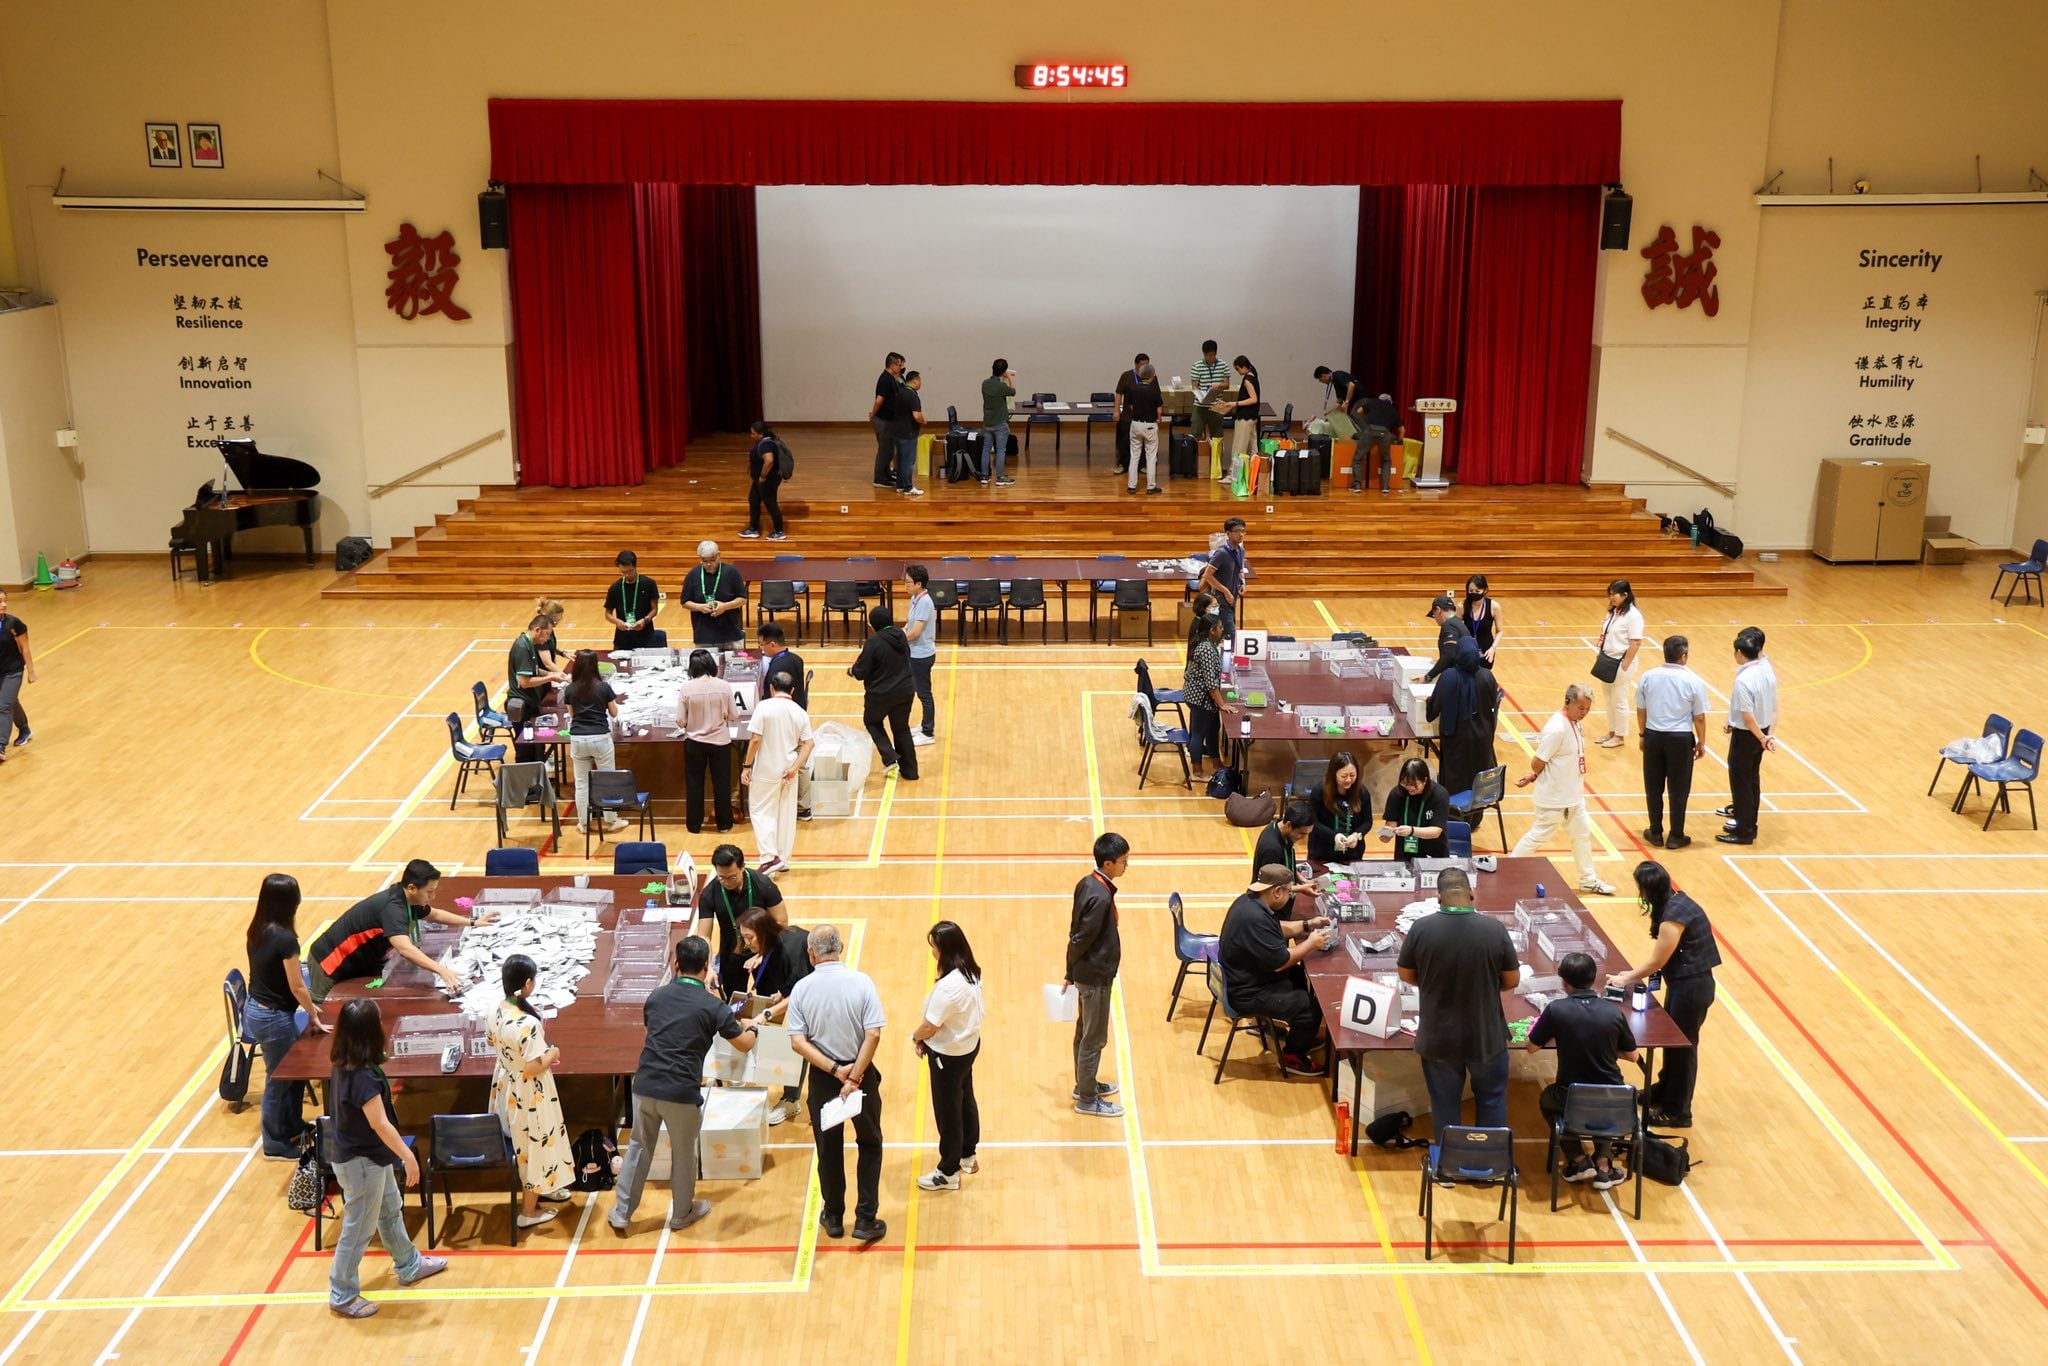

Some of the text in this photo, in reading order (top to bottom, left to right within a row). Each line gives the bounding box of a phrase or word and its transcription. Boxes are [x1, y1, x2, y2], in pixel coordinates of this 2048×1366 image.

[1033, 65, 1125, 86] 8:54:45
[136, 247, 269, 268] Perseverance
[1858, 248, 1943, 273] Sincerity
[384, 222, 472, 321] 毅
[176, 315, 244, 329] Resilience
[1865, 316, 1922, 332] Integrity
[179, 376, 252, 390] Innovation
[1859, 374, 1915, 391] Humility
[187, 415, 254, 432] 止于至善
[1847, 413, 1916, 429] 饮水思源
[1849, 433, 1912, 447] Gratitude
[1244, 637, 1259, 656] B
[733, 690, 748, 711] A
[1351, 992, 1377, 1025] D
